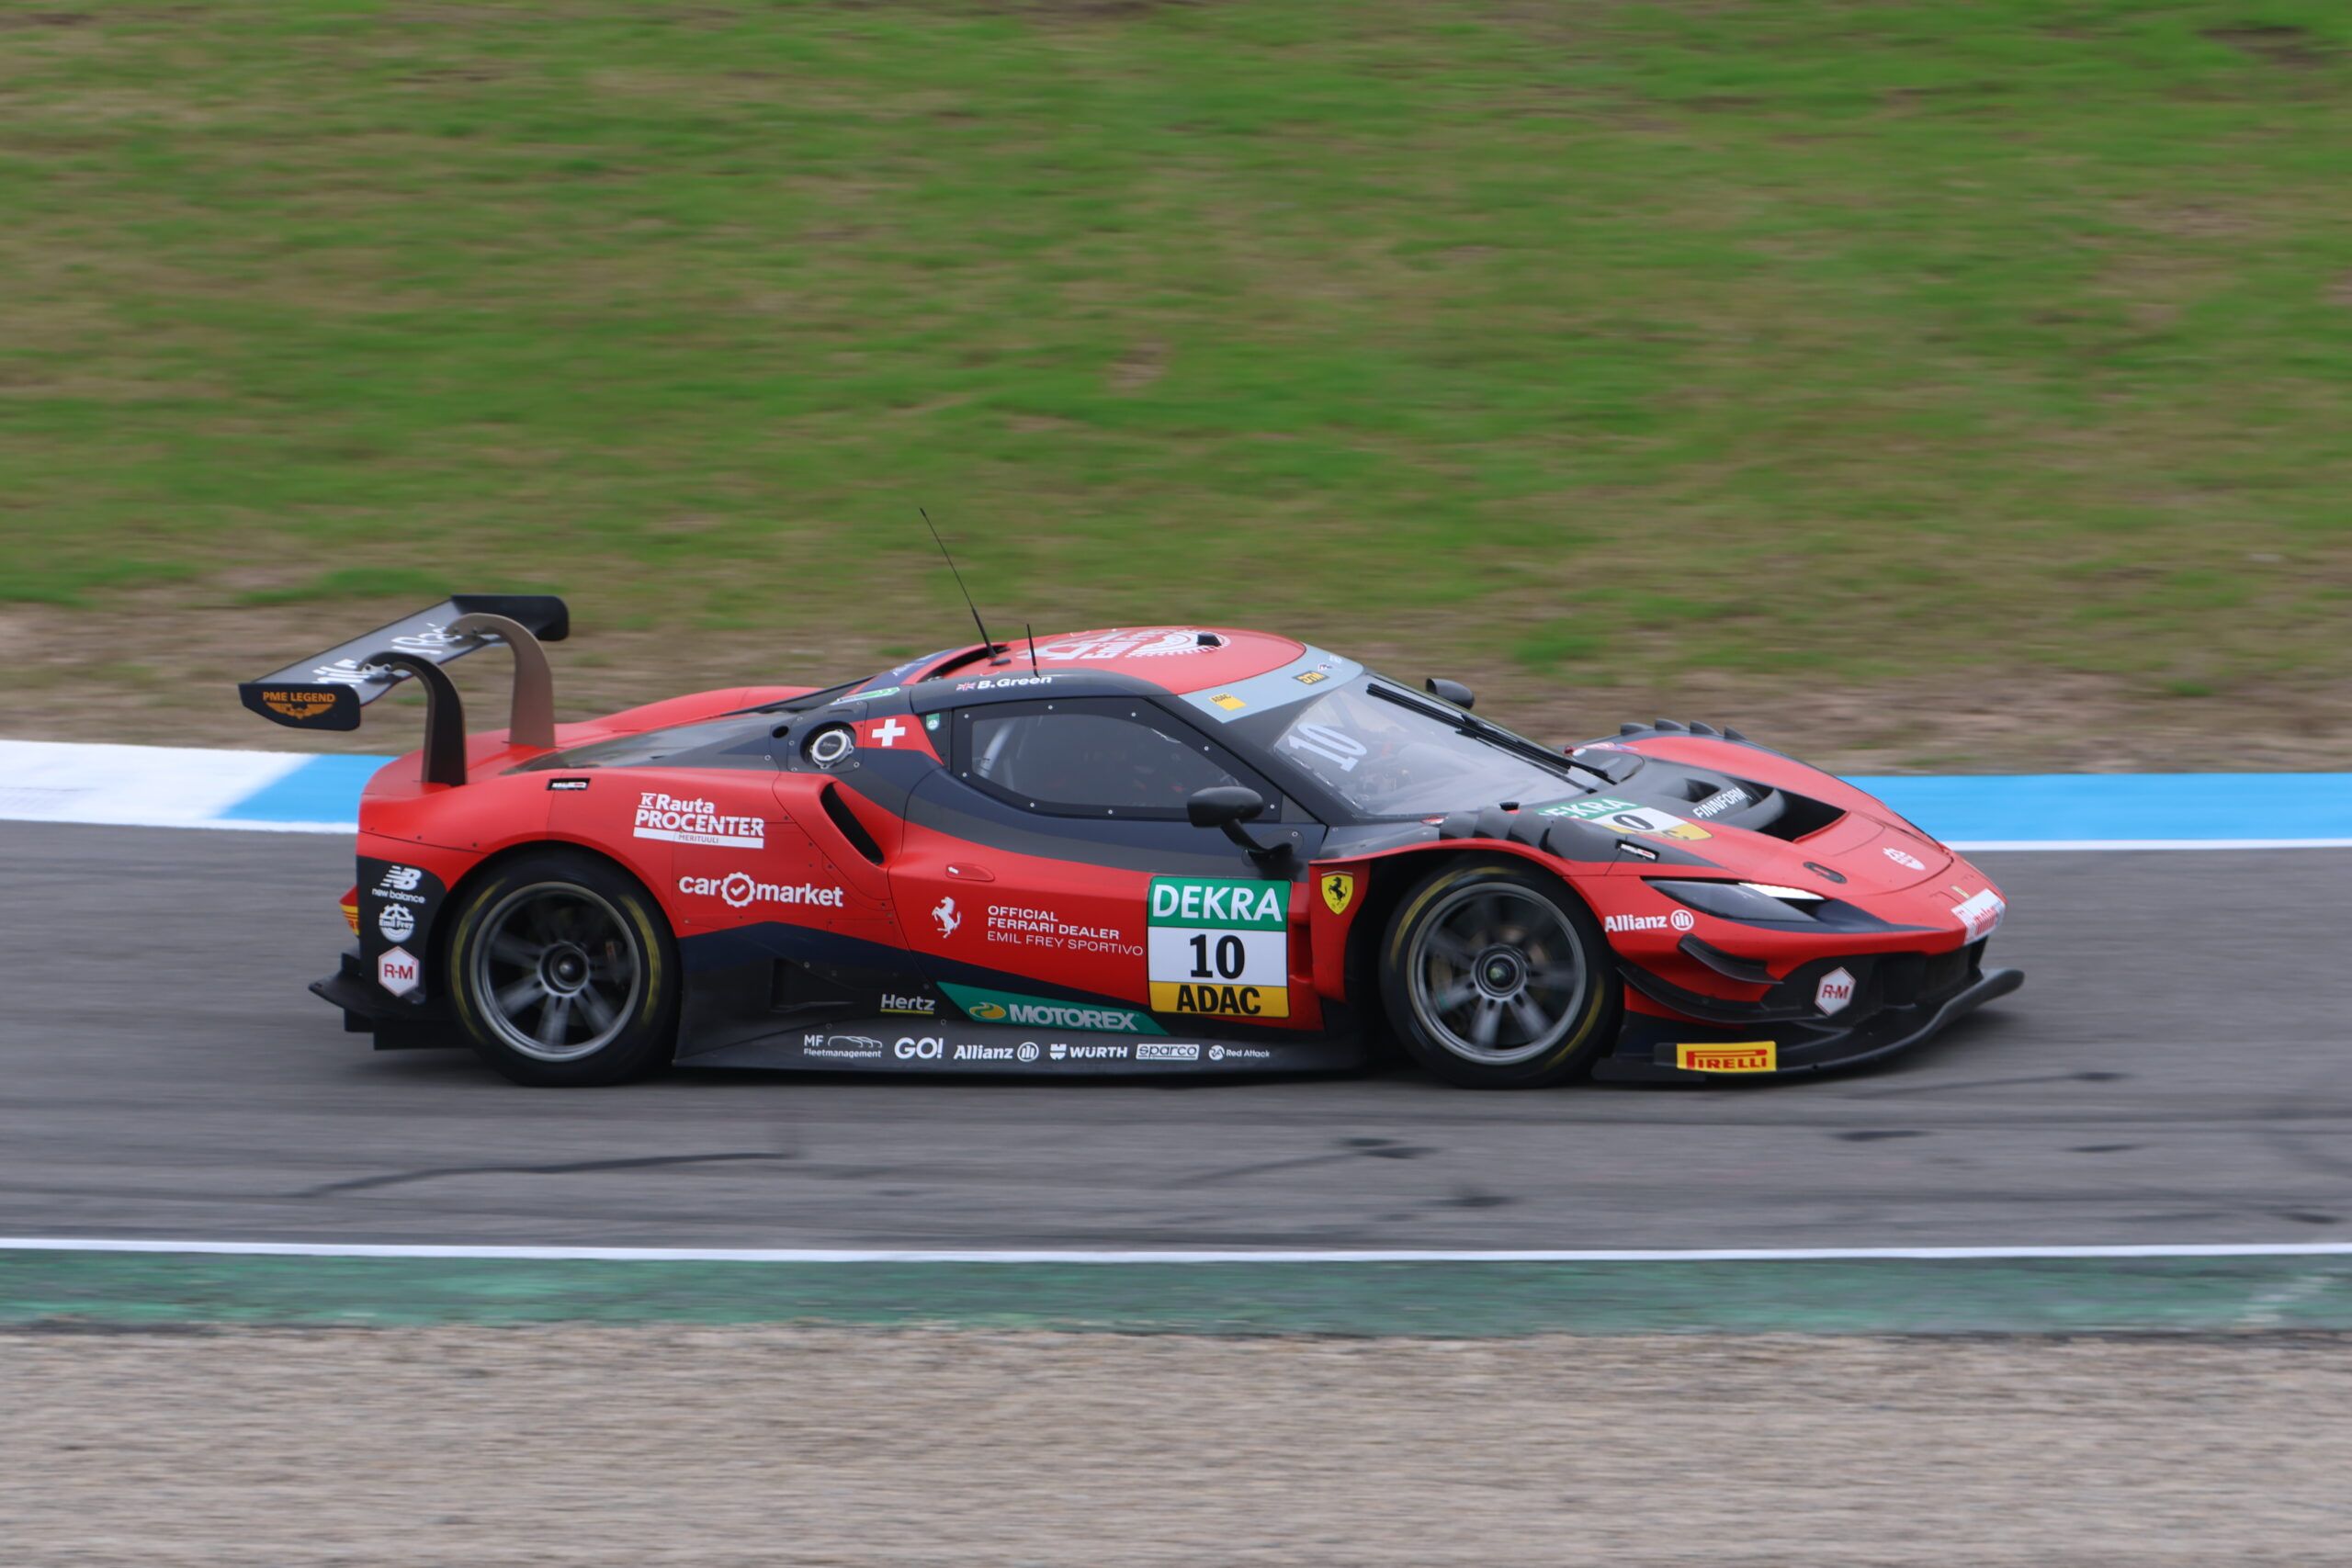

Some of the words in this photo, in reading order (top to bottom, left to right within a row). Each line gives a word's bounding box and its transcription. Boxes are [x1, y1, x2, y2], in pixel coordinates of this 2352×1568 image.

[977, 676, 1052, 690] B.Green
[263, 692, 287, 702] PME
[290, 693, 336, 703] LEGEND
[1287, 722, 1368, 773] 10
[1537, 797, 1639, 819] EKRA
[635, 808, 764, 837] PROCENTER
[677, 832, 719, 844] MERITUULI
[372, 888, 388, 897] new
[390, 889, 426, 904] balance
[1152, 884, 1283, 922] DEKRA
[988, 905, 1058, 922] OFFICIAL
[988, 917, 1055, 934] FERRARI
[1058, 923, 1120, 941] DEALER
[1604, 914, 1668, 932] Allianz
[987, 931, 1022, 944] EMIL
[1025, 933, 1064, 949] FREY
[1068, 938, 1144, 957] SPORTIVO
[1189, 933, 1246, 980] 10
[880, 994, 936, 1010] Hertz
[1176, 984, 1262, 1015] ADAC
[1008, 1003, 1138, 1032] MOTOREX
[803, 1034, 824, 1046] MF
[894, 1037, 944, 1059] GO!
[803, 1047, 882, 1058] Fleetmanagement
[953, 1044, 1013, 1060] Allianz
[1069, 1045, 1128, 1058] WÜRTH
[1138, 1044, 1198, 1057] sparco
[1226, 1049, 1242, 1057] Red
[1244, 1048, 1270, 1058] Attack
[1686, 1049, 1768, 1070] PIRELLI
